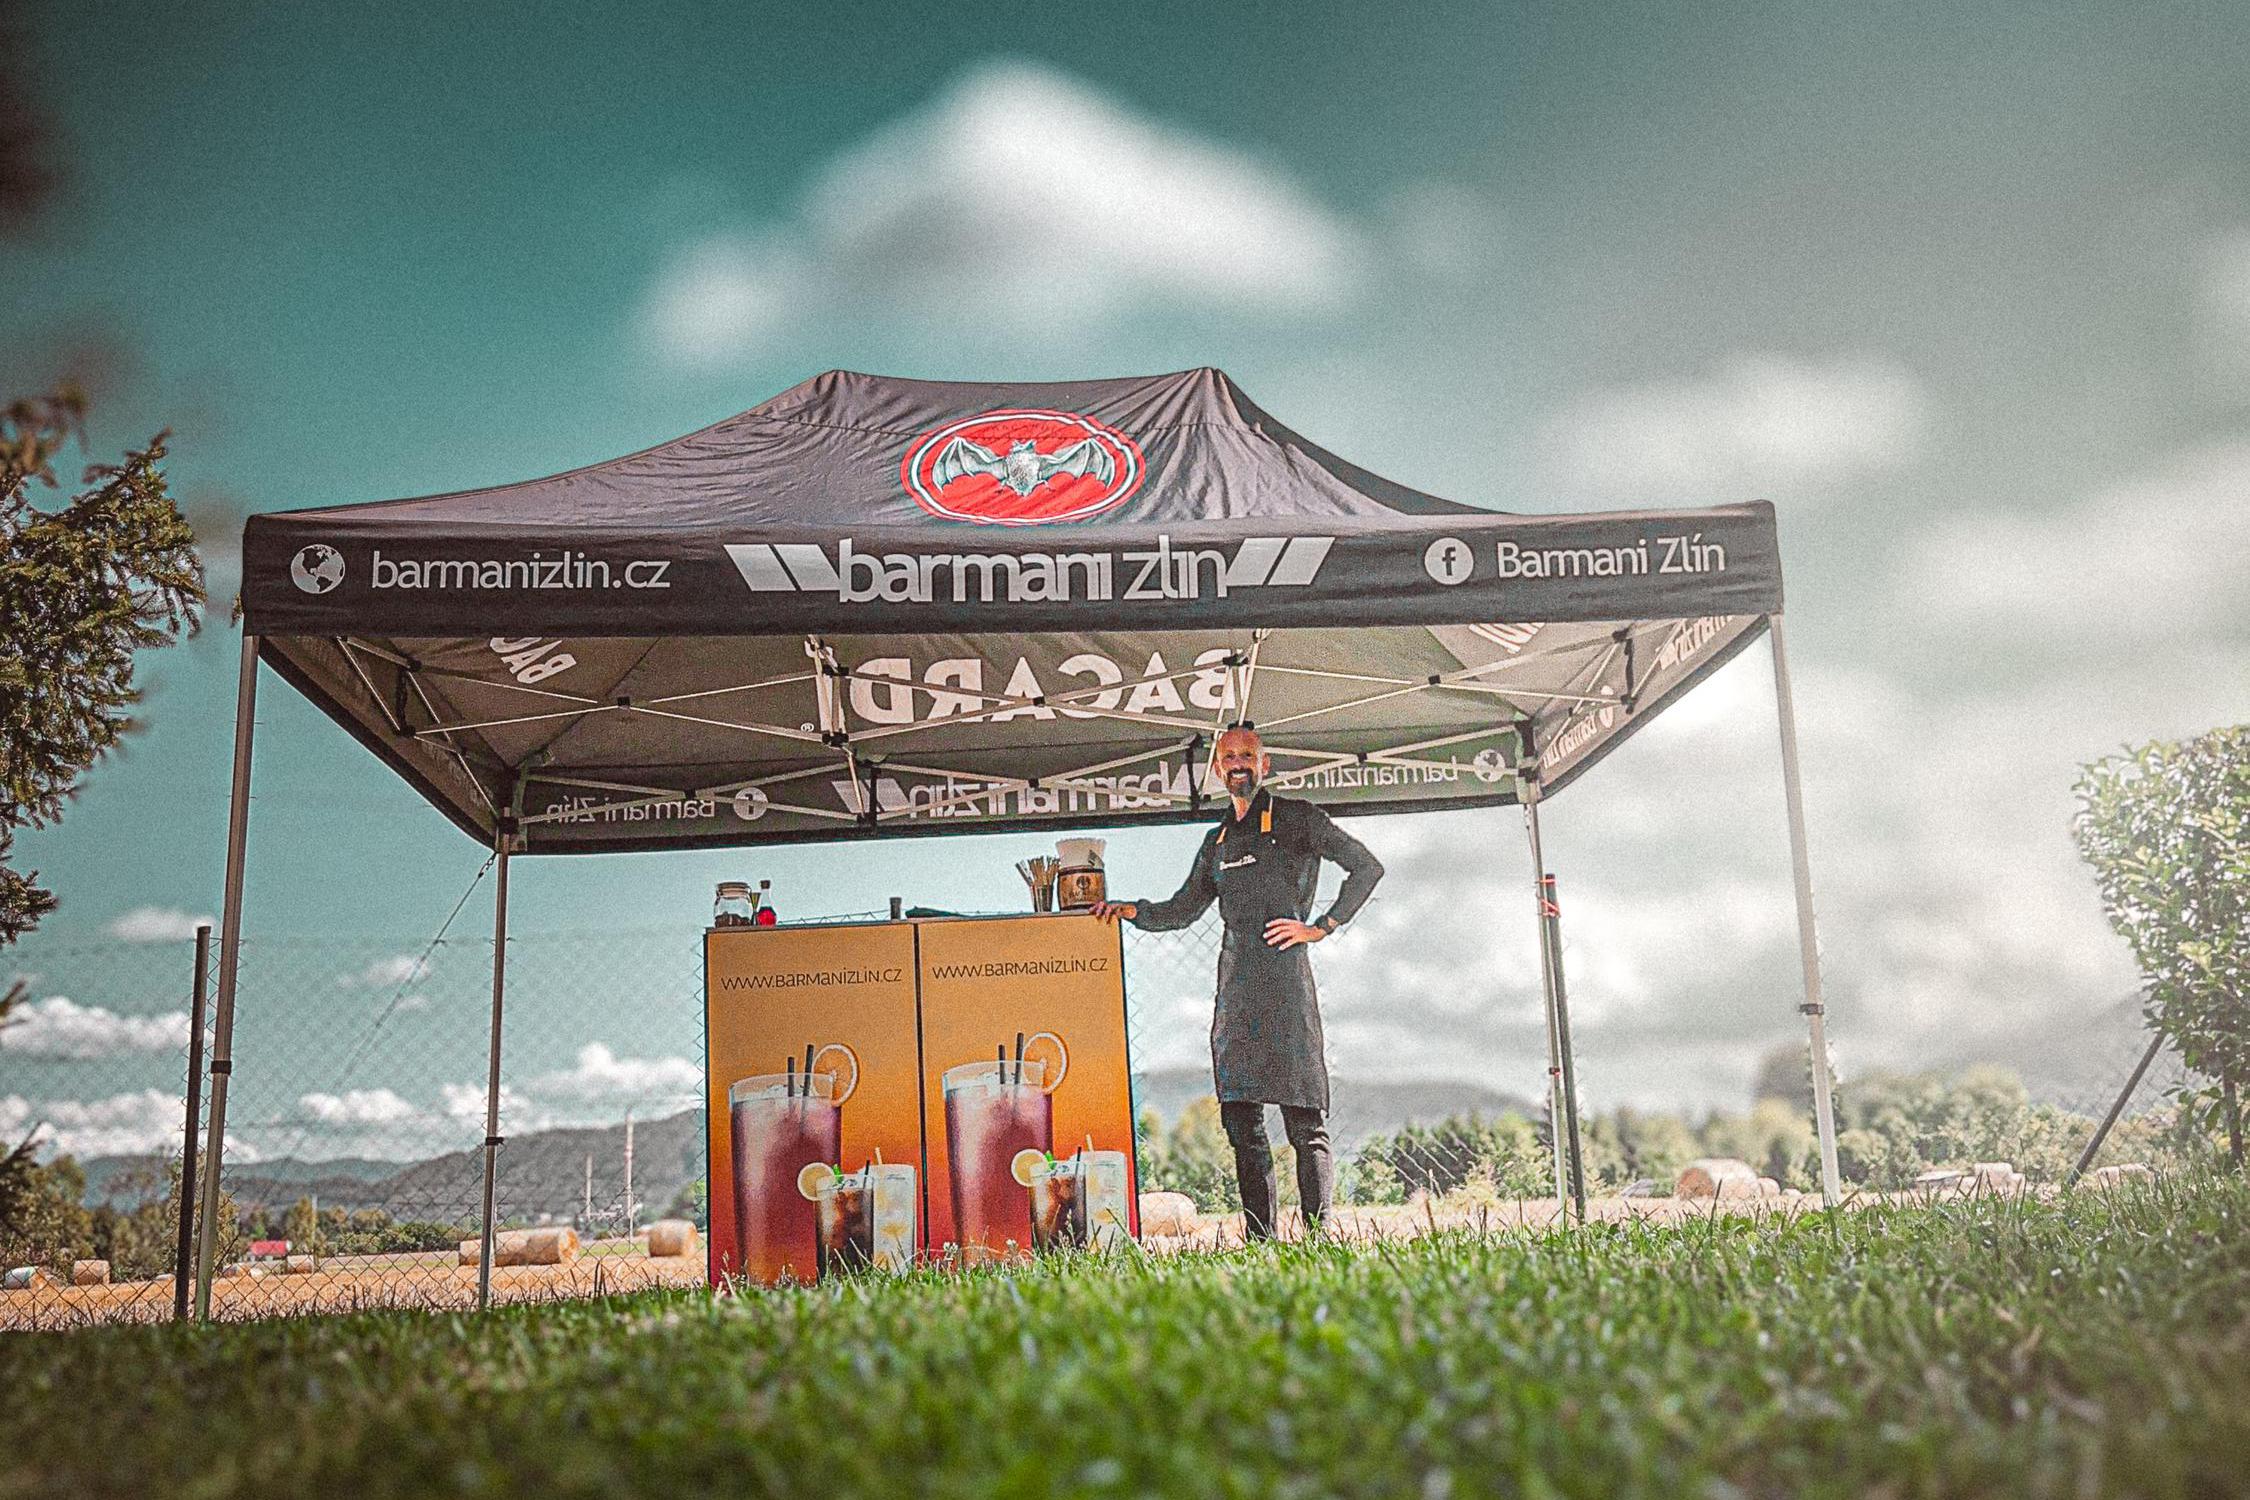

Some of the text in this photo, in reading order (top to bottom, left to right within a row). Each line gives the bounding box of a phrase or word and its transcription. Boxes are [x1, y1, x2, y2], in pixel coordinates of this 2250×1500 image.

[371, 550, 671, 589] barmanizlin.cz
[839, 534, 1229, 602] barmani zlin
[1497, 541, 1648, 579] Barmani
[1657, 533, 1726, 575] Zlín
